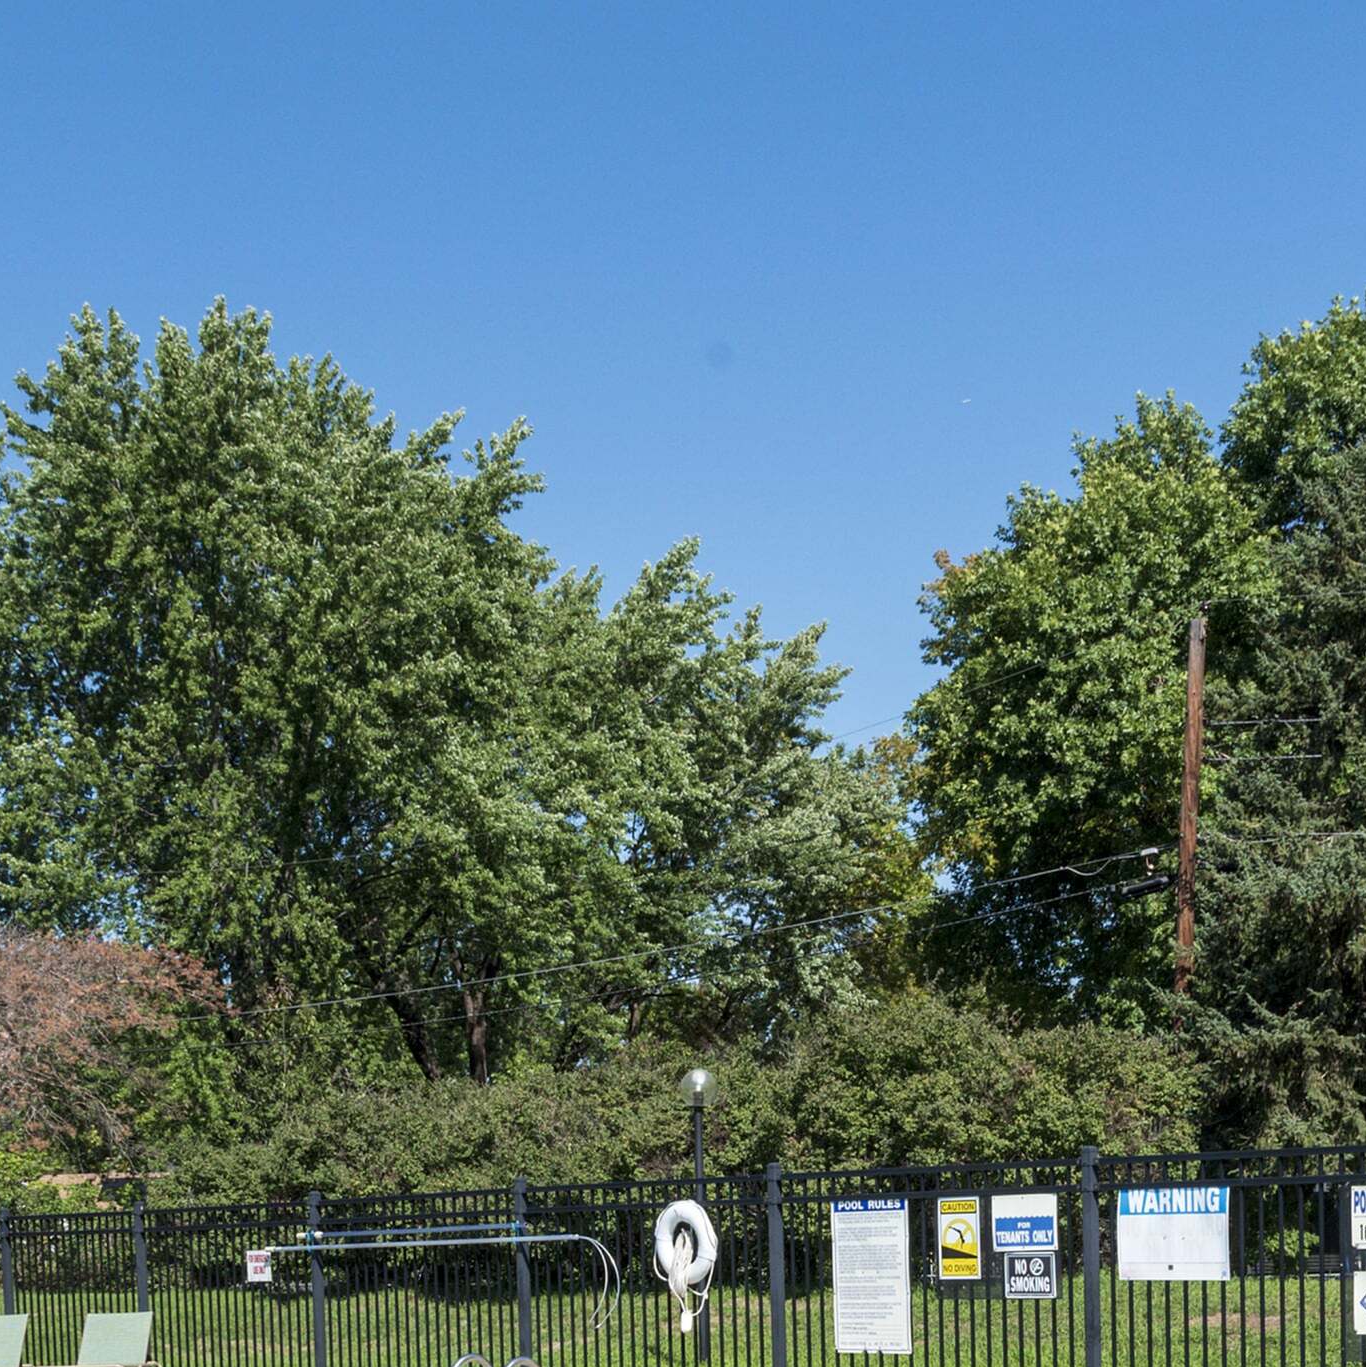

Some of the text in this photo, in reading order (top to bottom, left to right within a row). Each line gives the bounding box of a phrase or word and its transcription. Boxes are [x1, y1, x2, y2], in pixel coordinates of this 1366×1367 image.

[837, 1199, 901, 1211] POOL RULES
[942, 1203, 974, 1211] CAUTION
[1128, 1188, 1220, 1213] WARNING
[996, 1230, 1053, 1244] TENANTS ONLY
[943, 1264, 977, 1273] NO DIVING
[1015, 1259, 1027, 1275] NO
[1010, 1276, 1050, 1292] SMOKING
